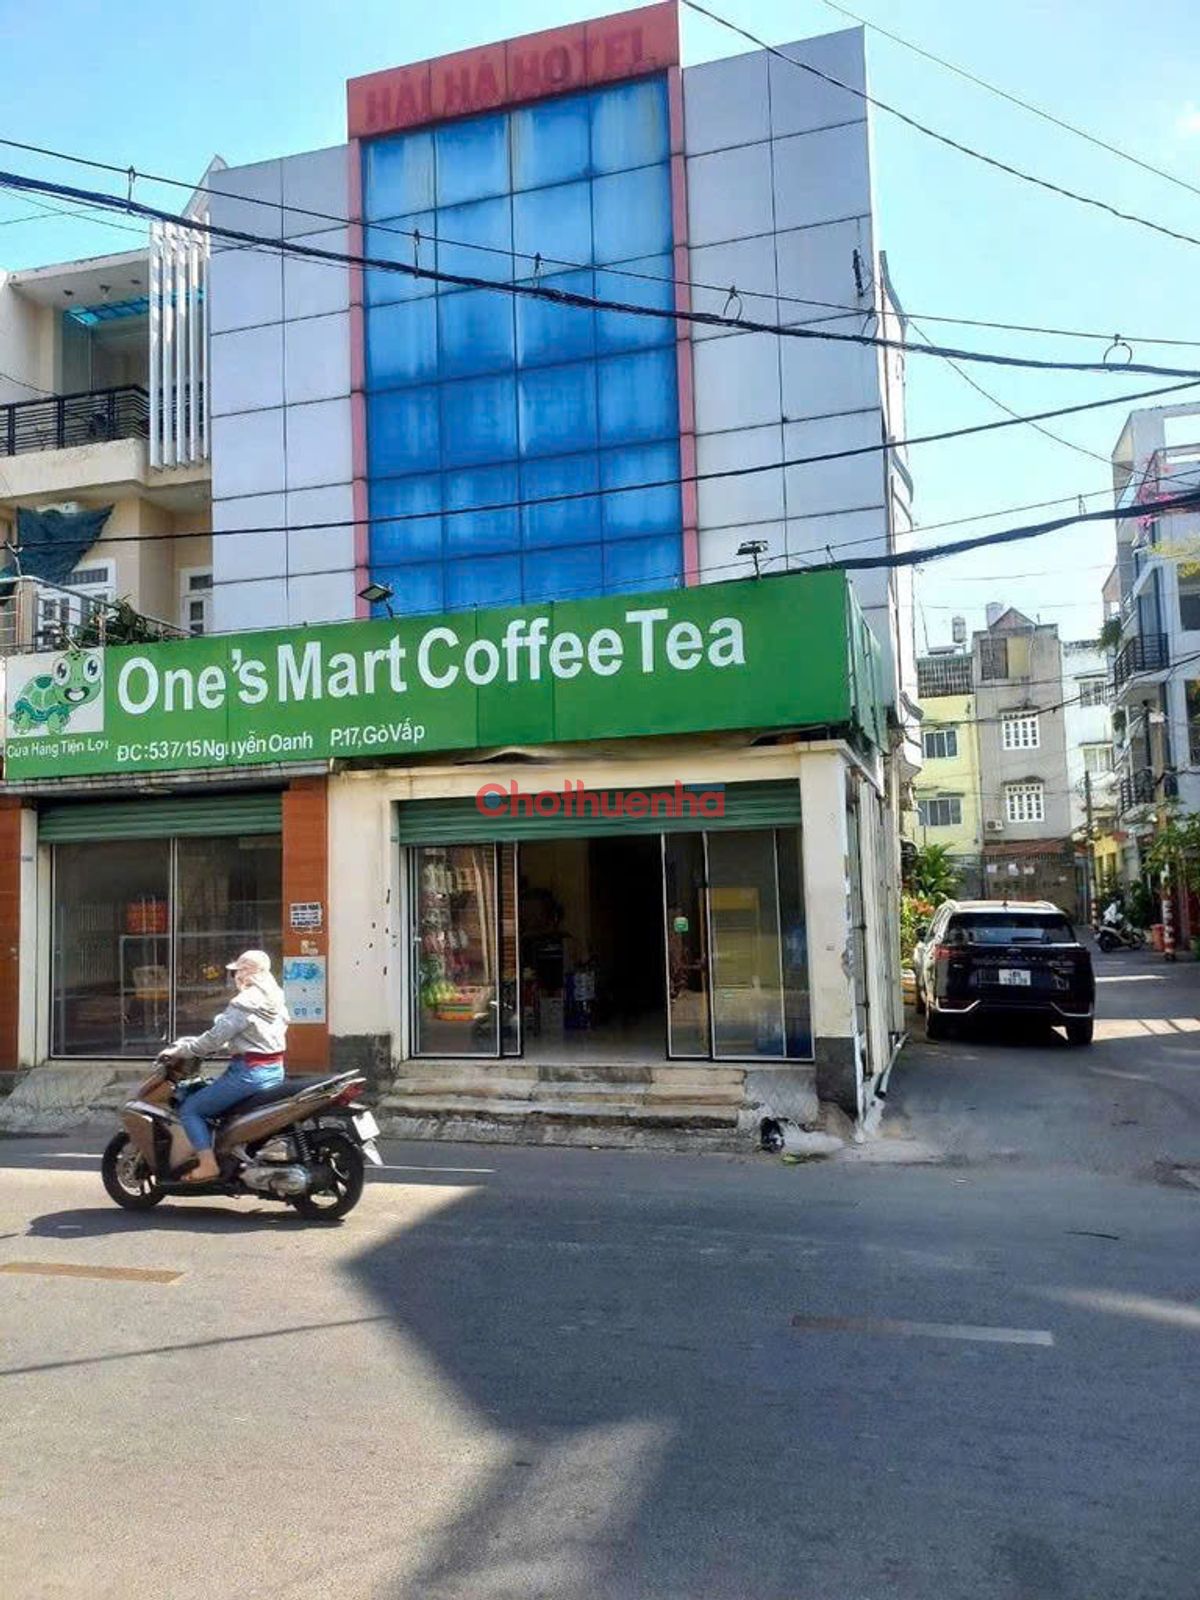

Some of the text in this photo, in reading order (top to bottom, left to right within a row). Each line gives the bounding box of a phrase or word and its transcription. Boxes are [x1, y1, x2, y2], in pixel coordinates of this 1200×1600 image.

[278, 634, 407, 702] Mart
[417, 618, 624, 689] Coffee
[626, 608, 746, 674] Tea
[269, 731, 313, 753] Oanh
